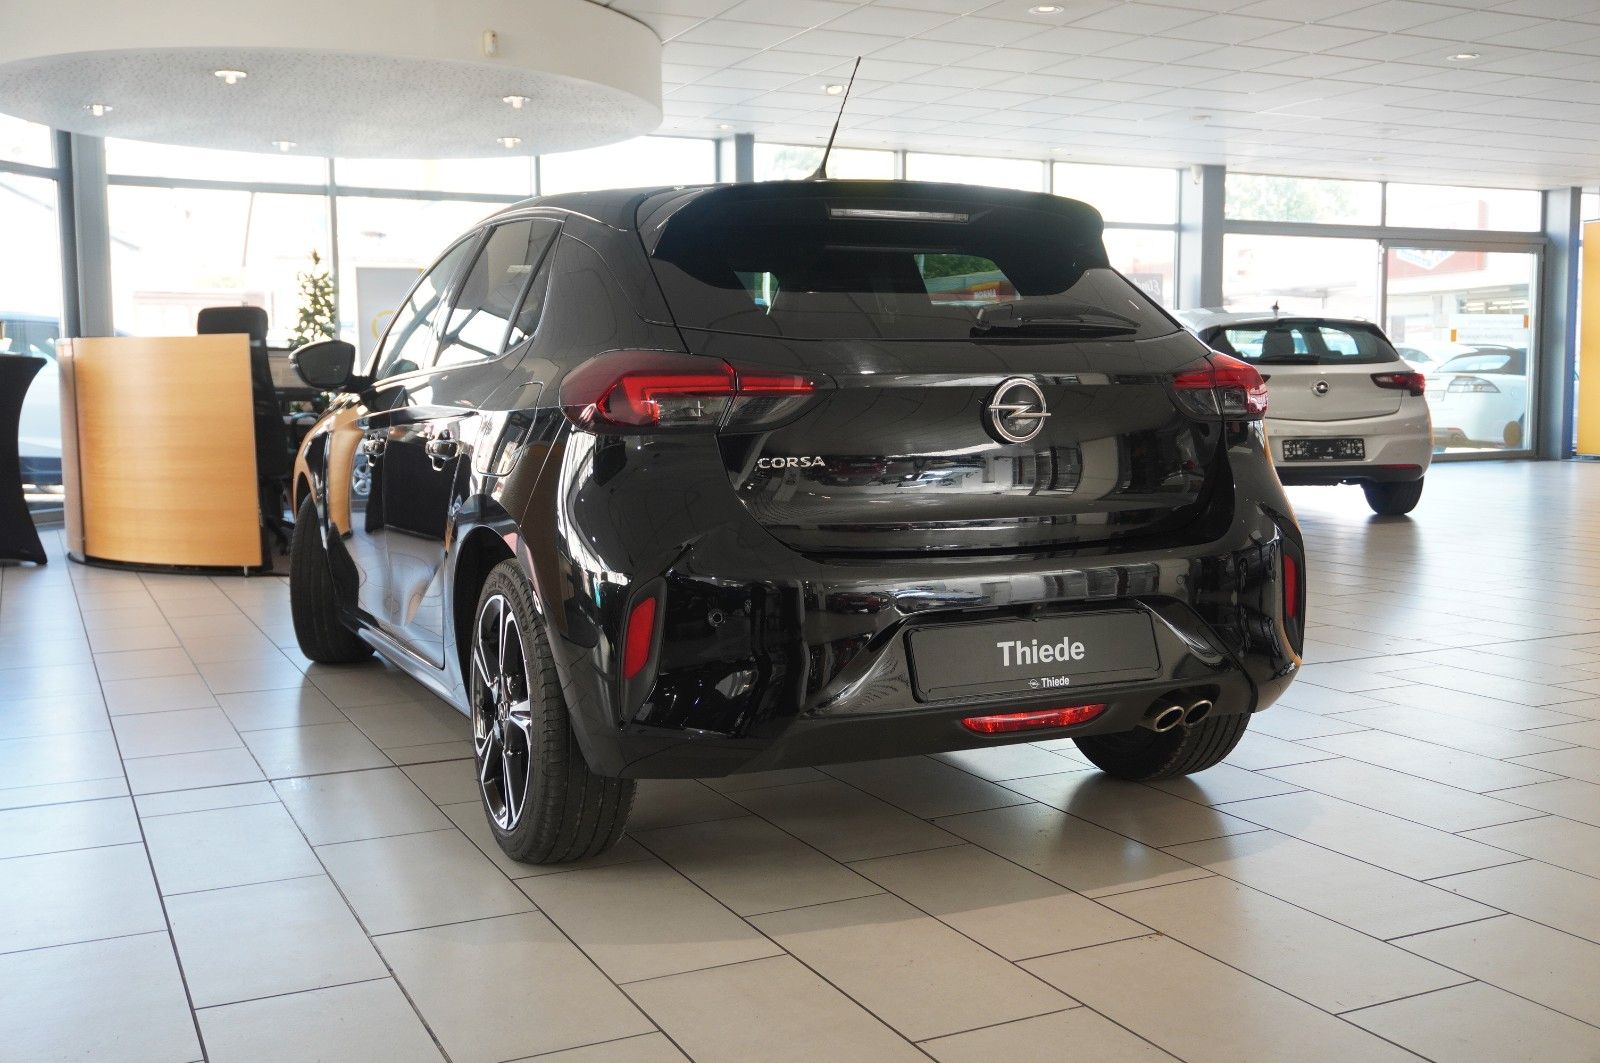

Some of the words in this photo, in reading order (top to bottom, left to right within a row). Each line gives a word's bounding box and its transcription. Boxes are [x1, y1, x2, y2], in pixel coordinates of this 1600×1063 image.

[757, 456, 826, 469] CORSA
[996, 636, 1085, 667] Thiede
[1040, 676, 1070, 688] Thiede
